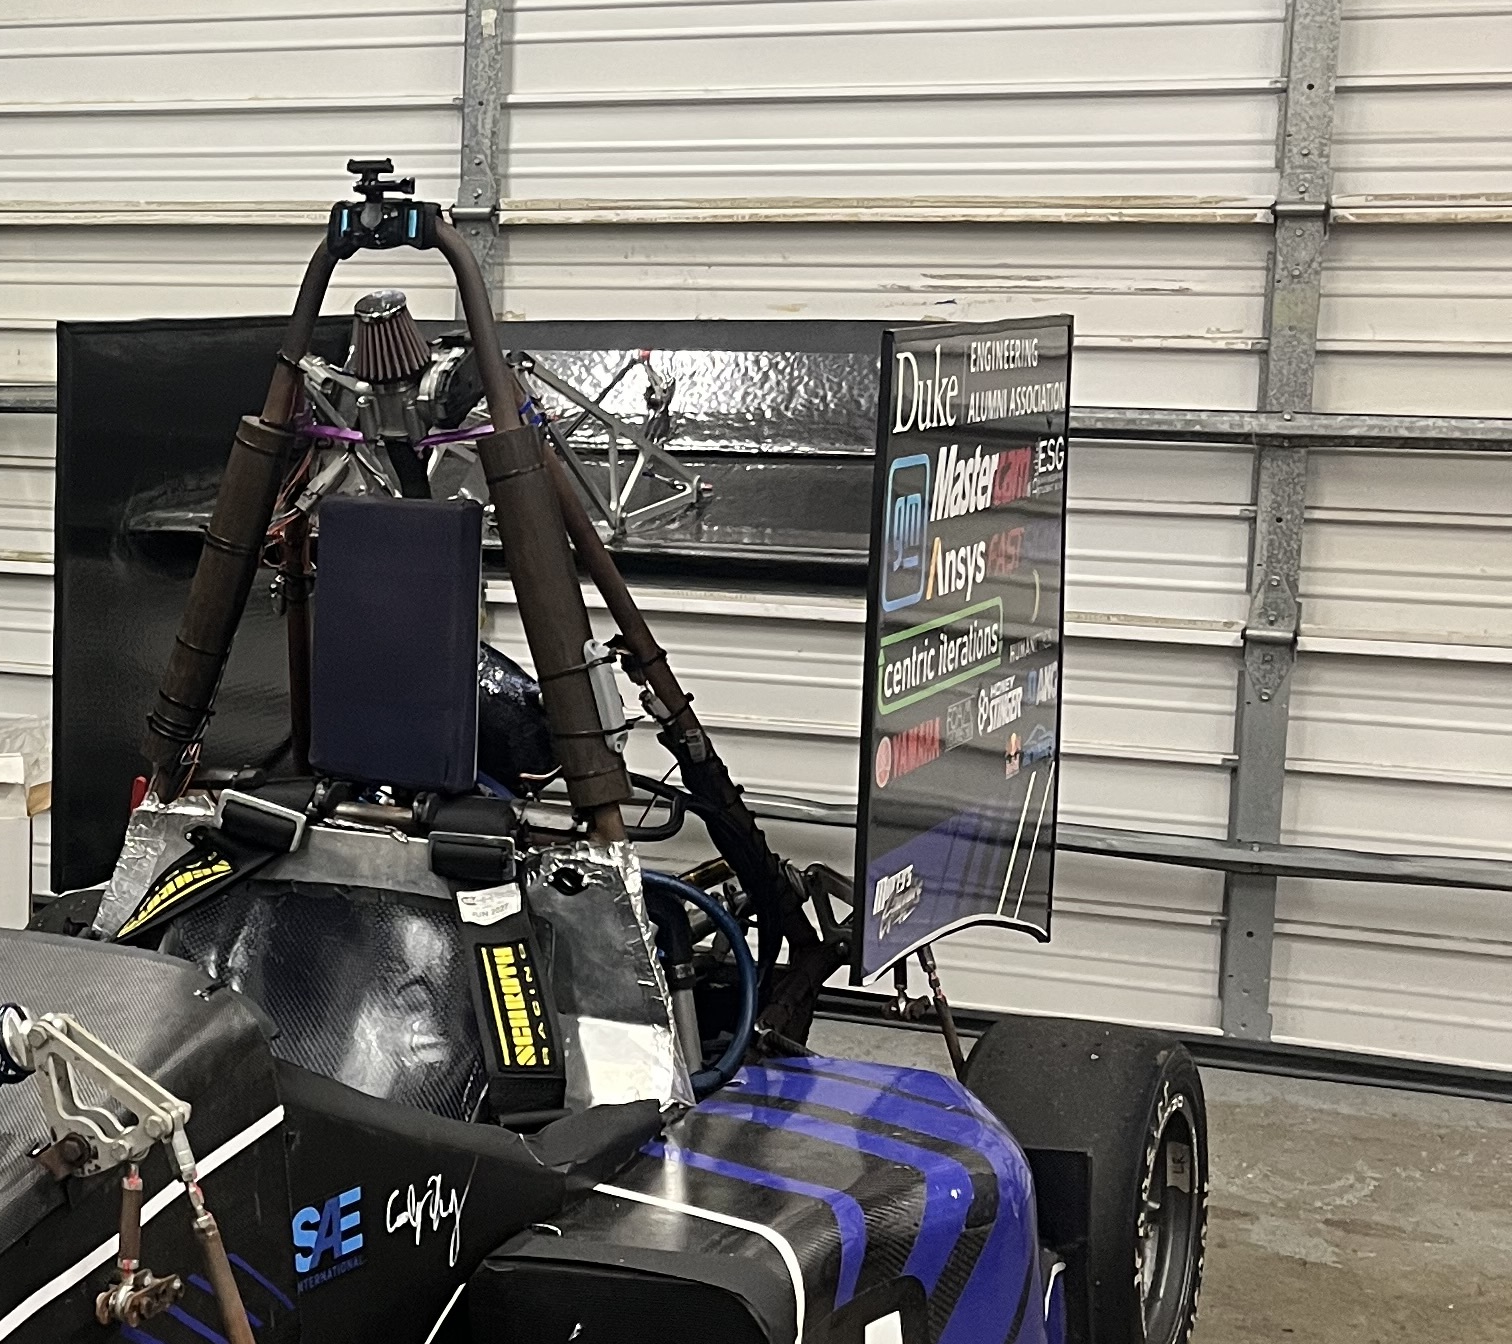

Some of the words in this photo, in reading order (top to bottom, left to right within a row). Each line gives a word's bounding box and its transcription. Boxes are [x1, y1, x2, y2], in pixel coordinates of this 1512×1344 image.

[892, 343, 959, 435] Duke
[969, 337, 1039, 374] ENGINEERING
[966, 387, 1008, 425] ALUMNI
[1008, 380, 1067, 417] ASSOCIATION
[1038, 435, 1065, 473] ESG
[892, 492, 922, 573] gm
[925, 535, 987, 602] Ansys
[883, 637, 936, 699] centric
[937, 619, 1000, 678] iterations
[986, 686, 1024, 734] STINGER
[291, 1185, 364, 1274] SAE
